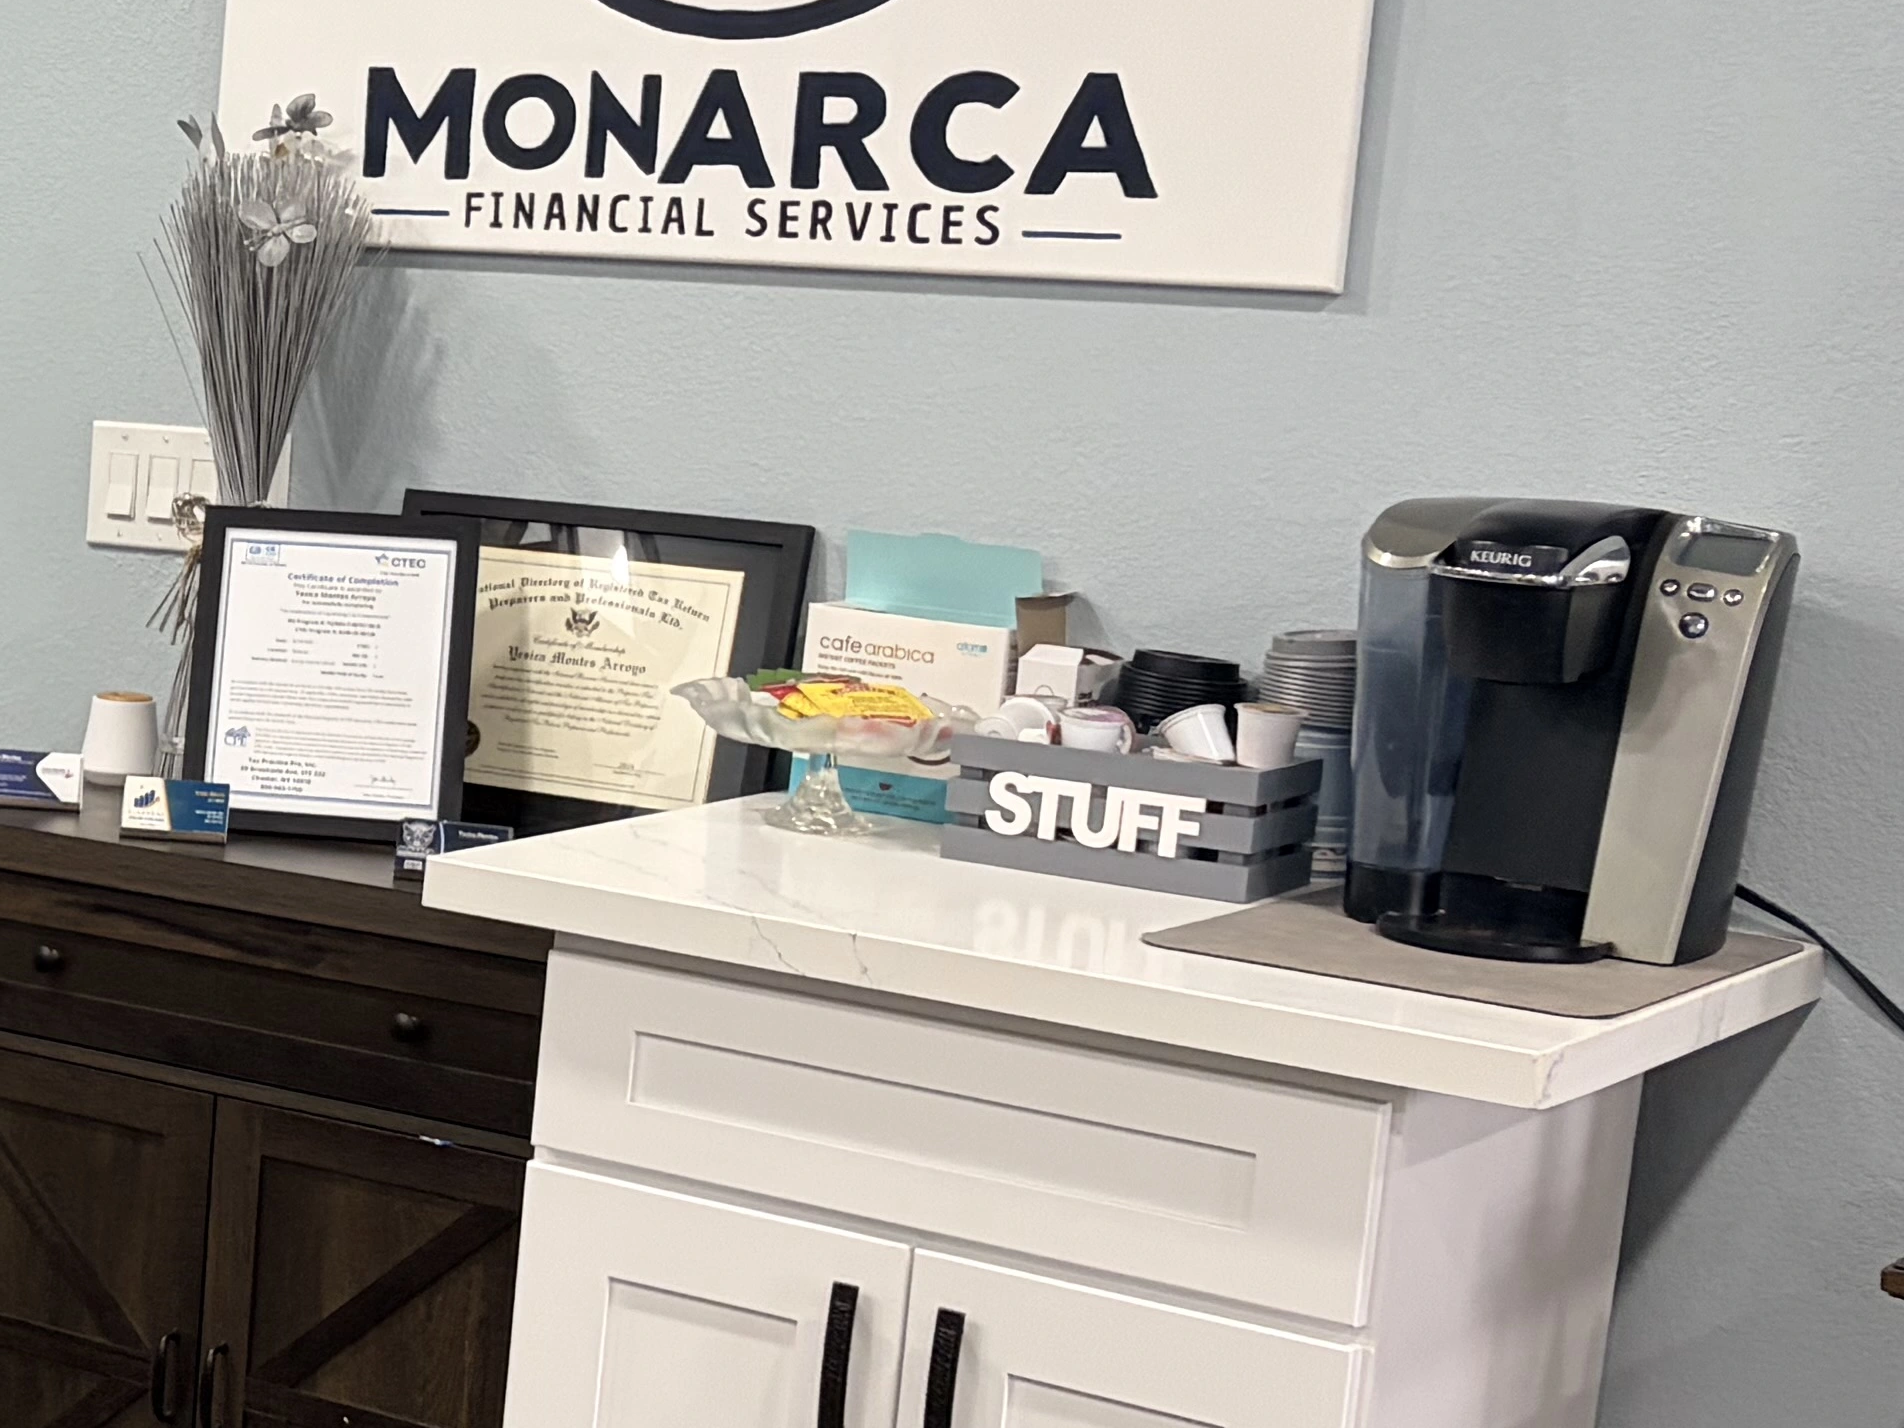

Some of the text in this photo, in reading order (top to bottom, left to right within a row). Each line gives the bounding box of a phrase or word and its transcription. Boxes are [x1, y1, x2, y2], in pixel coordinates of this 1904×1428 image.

[362, 64, 1159, 200] MONARCA
[462, 190, 1002, 248] FINANCIAL SERVICES
[391, 557, 426, 569] CTEC
[1470, 550, 1532, 568] KEURIG
[287, 573, 334, 583] Certificate
[349, 576, 399, 587] Completion
[478, 579, 515, 593] ational
[520, 577, 569, 590] Directory
[573, 578, 584, 588] of
[589, 578, 644, 598] Registered
[674, 598, 710, 623] Return
[550, 593, 571, 603] and
[575, 592, 655, 619] Professionals
[508, 645, 646, 675] Yesica Montes Arroyo
[819, 635, 935, 665] cafe arabica
[984, 771, 1206, 858] STUFF
